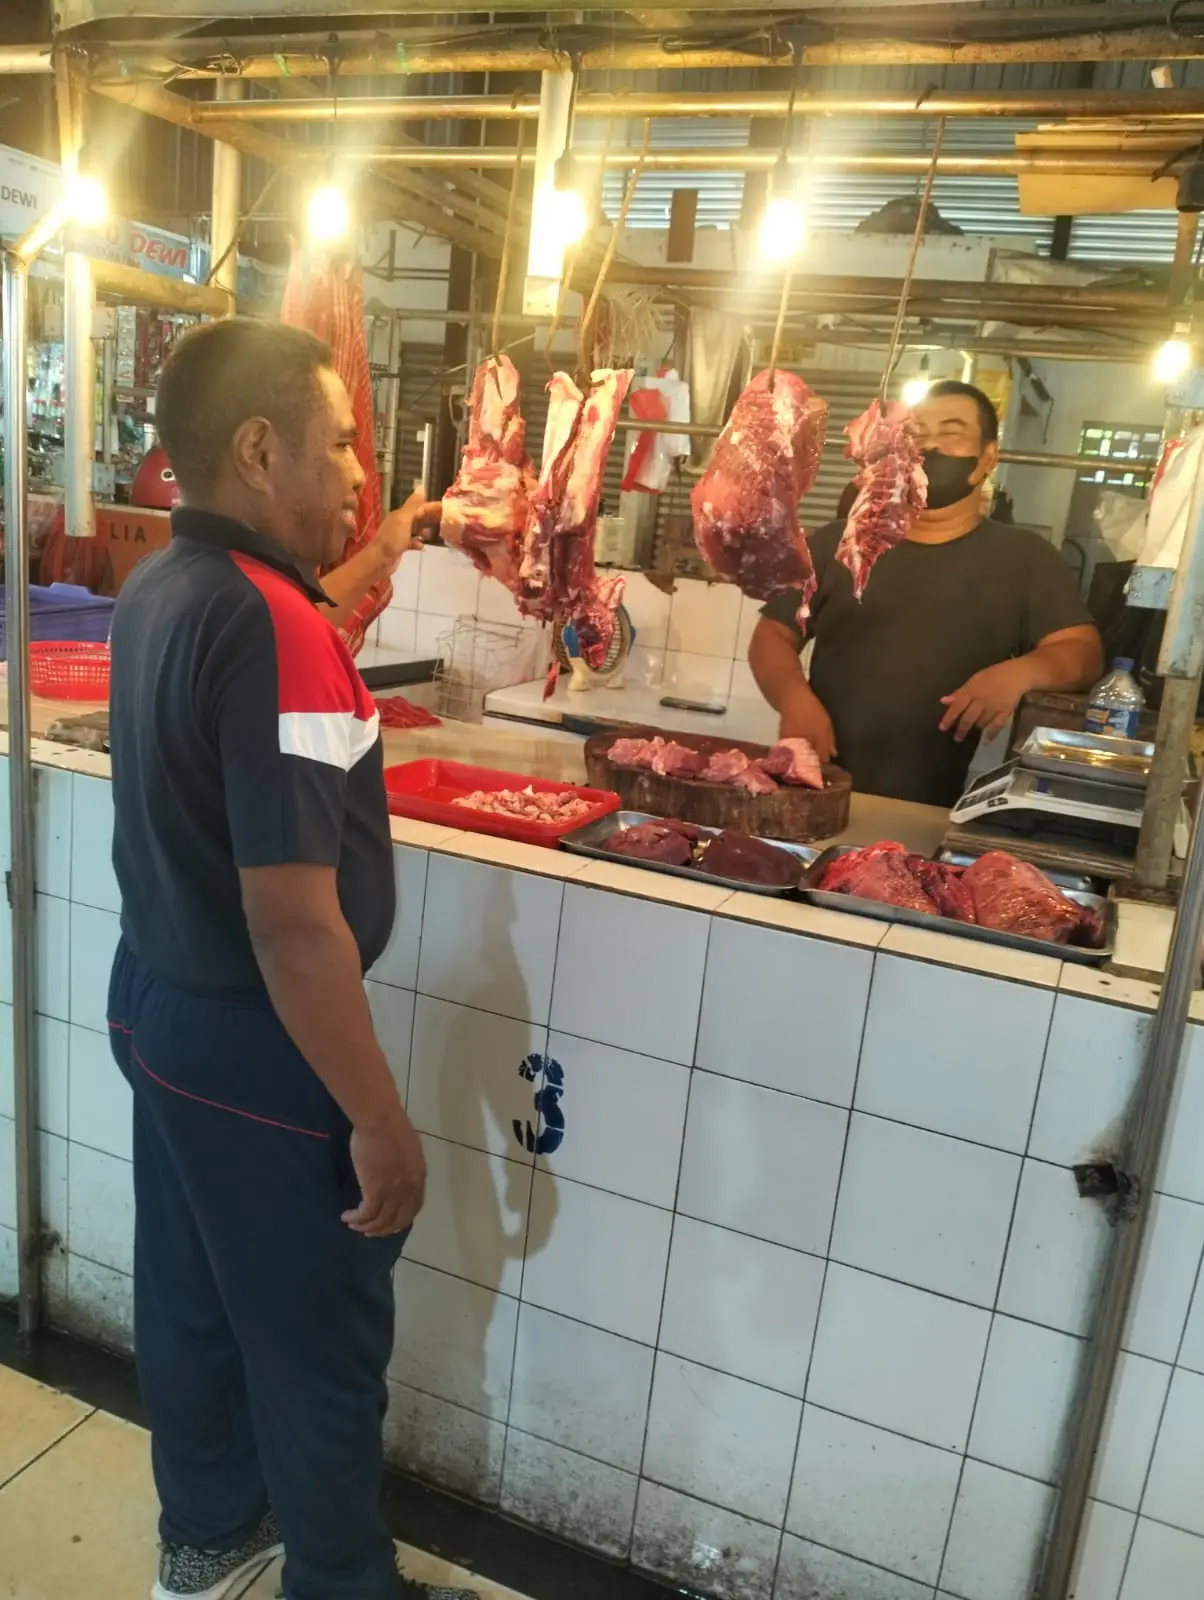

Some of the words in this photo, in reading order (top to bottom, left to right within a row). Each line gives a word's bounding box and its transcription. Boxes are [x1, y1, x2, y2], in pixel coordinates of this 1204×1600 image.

[1, 185, 37, 210] DEWI
[129, 231, 188, 269] DEWI
[511, 1053, 565, 1155] 3
